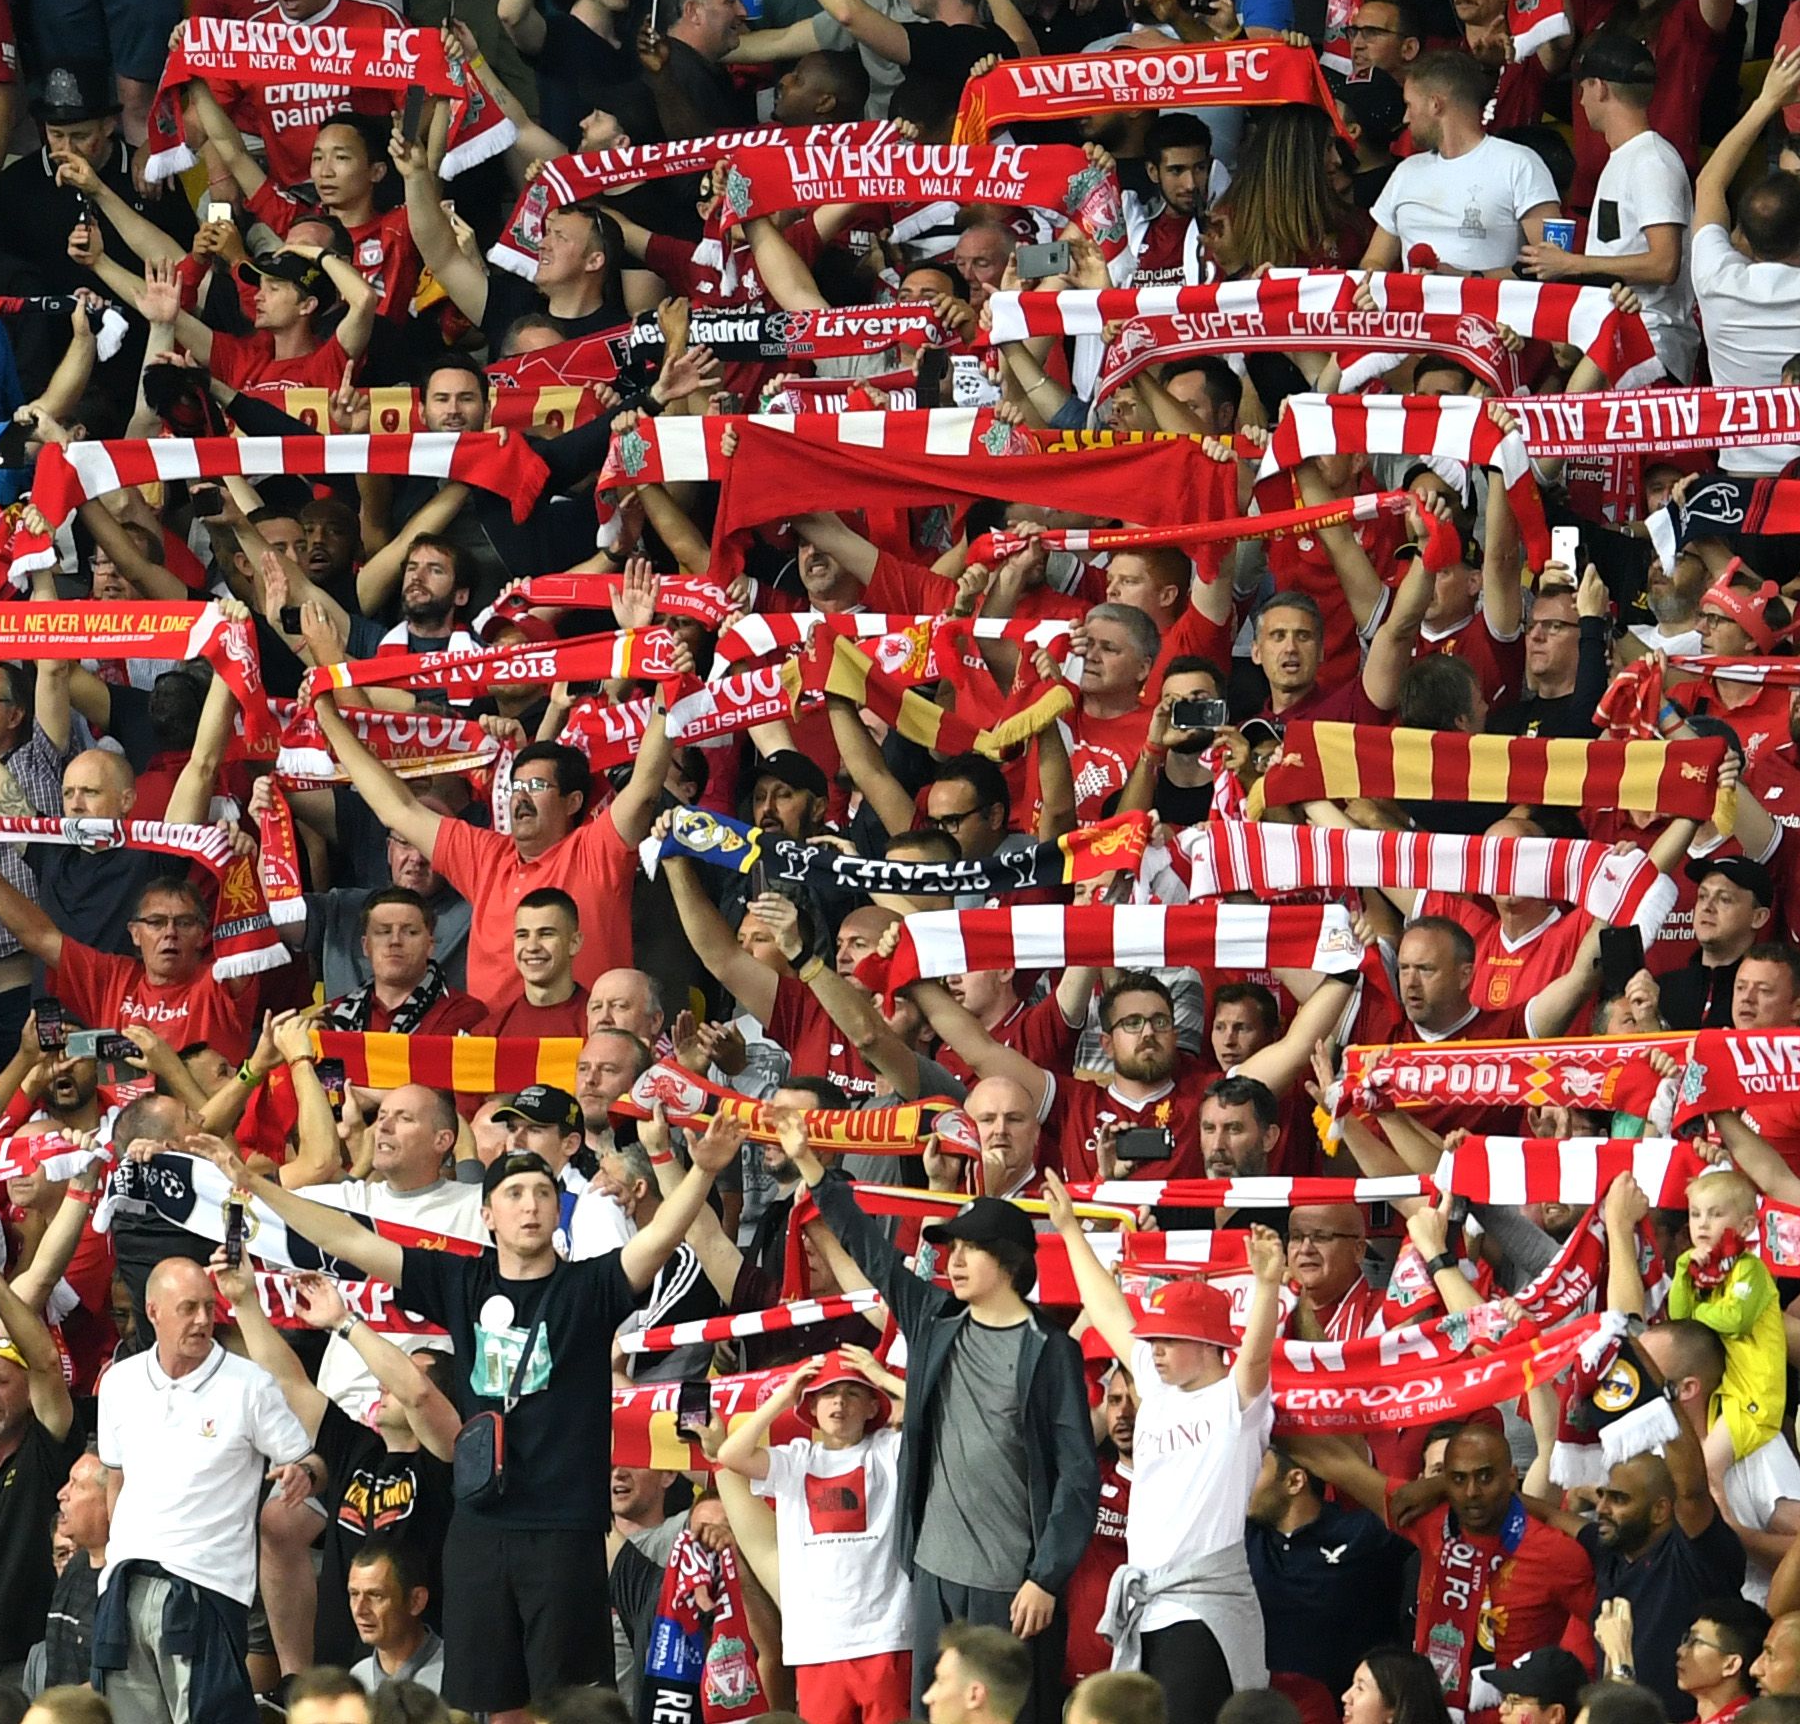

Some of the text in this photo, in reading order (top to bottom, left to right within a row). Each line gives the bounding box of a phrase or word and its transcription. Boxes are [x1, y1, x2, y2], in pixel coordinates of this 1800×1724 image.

[185, 17, 421, 64] LIVERPOOL FC
[185, 51, 417, 80] YOU'LL NEVER WALK ALONE
[1015, 48, 1270, 97] LIVERPOOL FC
[265, 83, 351, 107] crown
[1114, 85, 1176, 103] EST 1892
[1172, 310, 1433, 342] SUPER LIVERPOOL
[1604, 396, 1697, 441] ALLEZ
[22, 614, 79, 633] NEVER
[82, 614, 130, 632] WALK
[134, 614, 196, 632] ALONE
